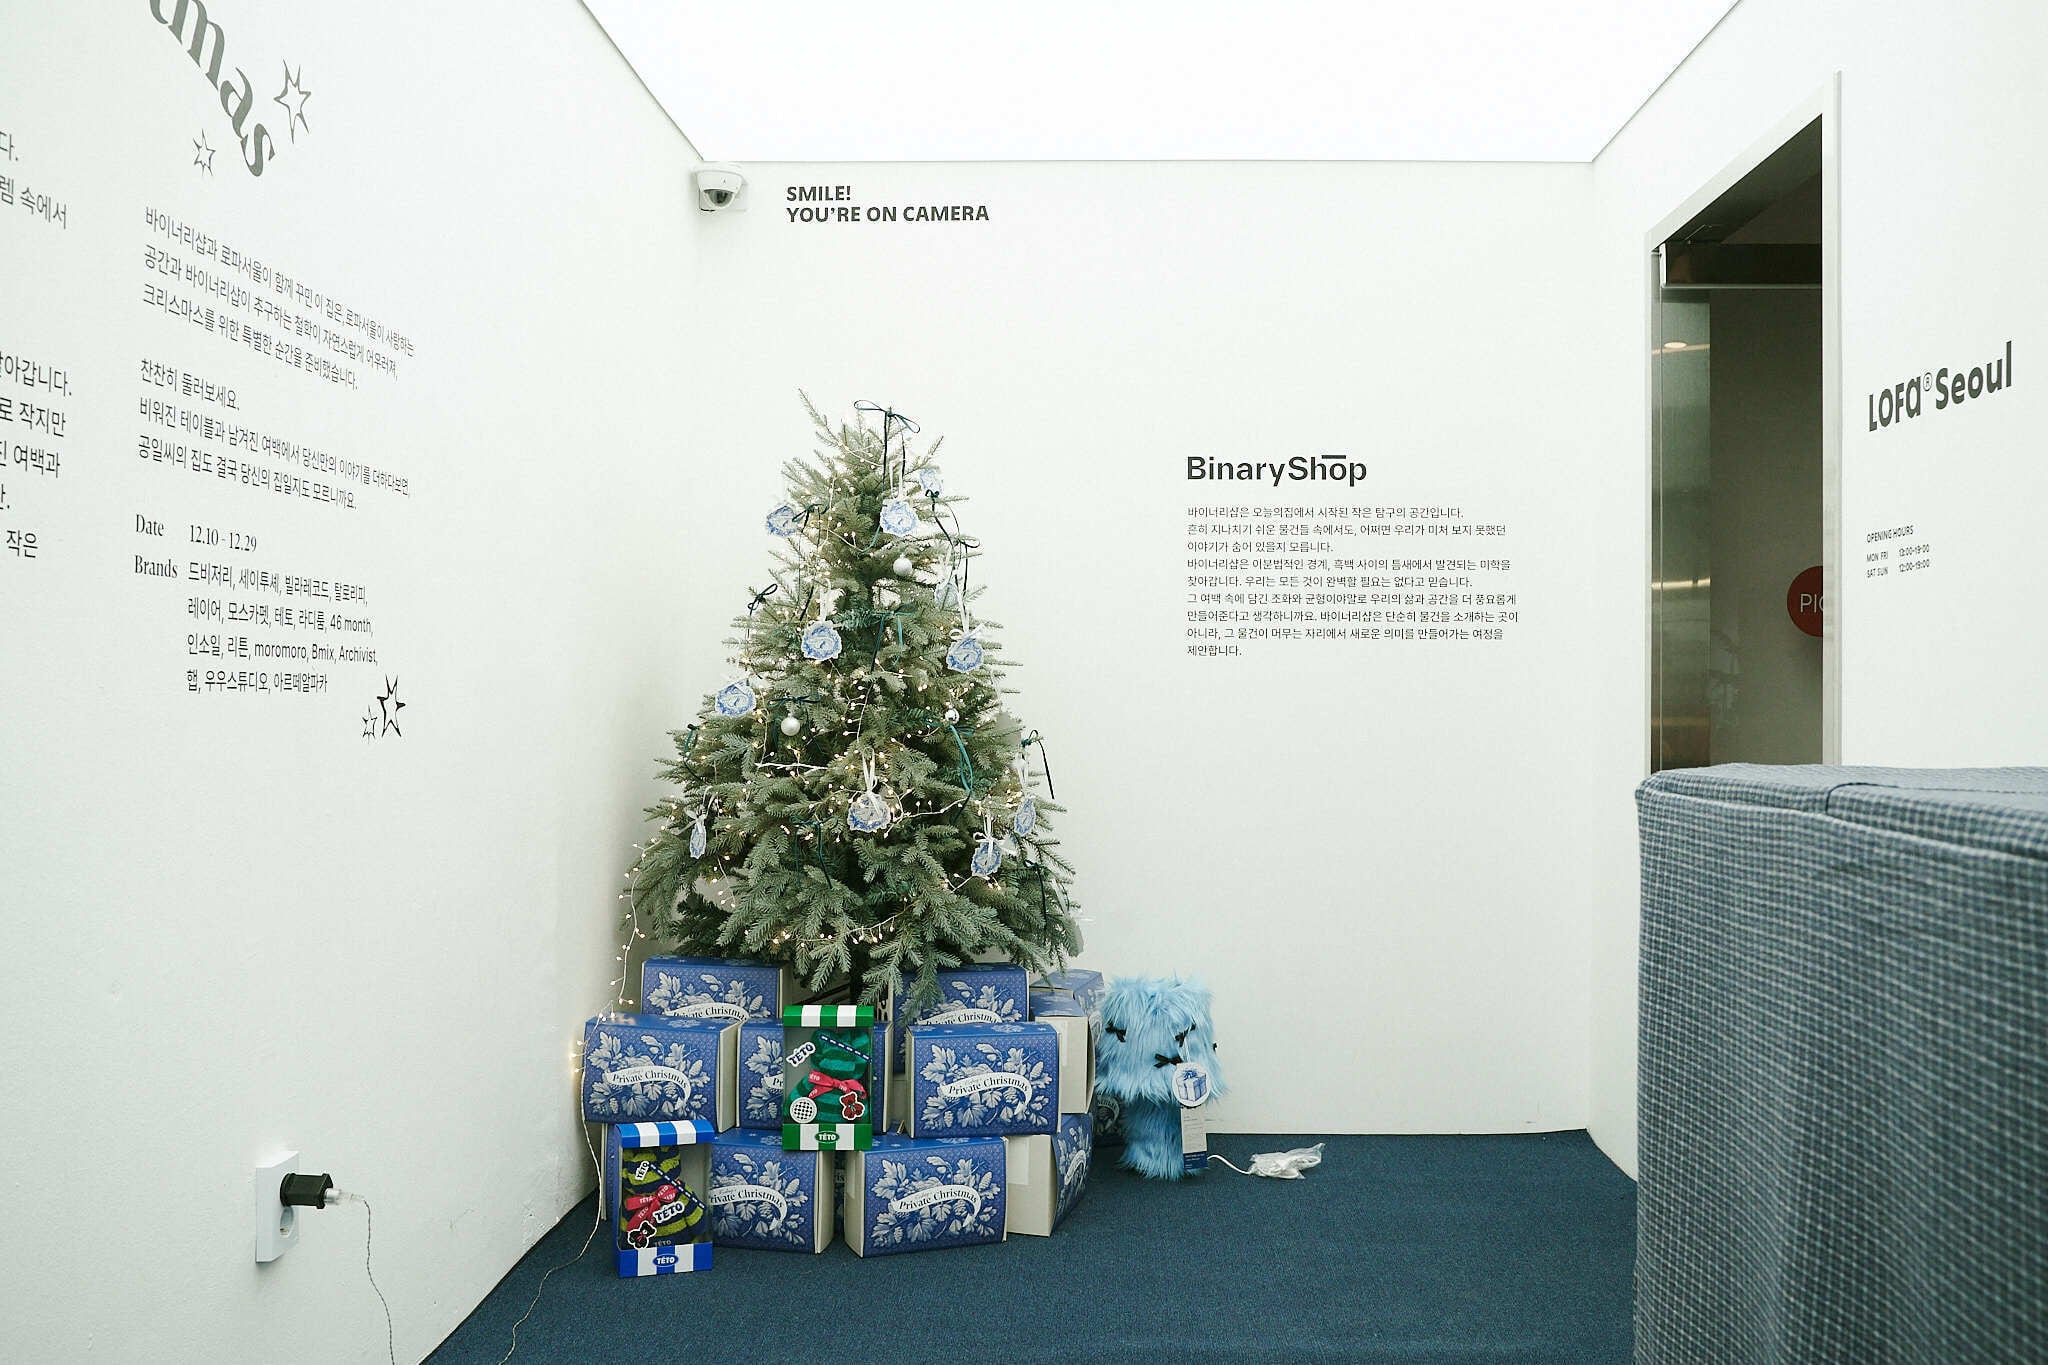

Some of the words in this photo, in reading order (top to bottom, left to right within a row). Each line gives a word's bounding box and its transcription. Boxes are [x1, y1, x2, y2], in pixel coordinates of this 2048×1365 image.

[786, 185, 851, 202] SMILE!
[20, 187, 67, 230] 속에서
[786, 206, 861, 223] YOU'RE
[866, 206, 897, 222] ON
[903, 205, 990, 222] CAMERA
[145, 206, 218, 261] 바이너리샵과
[220, 245, 272, 289] 로파서울이
[275, 271, 294, 300] 함께
[296, 282, 313, 309] 꾸민
[346, 308, 384, 344] 로파서울이
[144, 244, 182, 281] 공간과
[185, 263, 251, 313] 바이너리샵이
[253, 295, 292, 331] 추구하는
[294, 315, 321, 344] 철학이
[143, 283, 215, 332] 크리스마스를
[218, 315, 240, 342] 위한
[242, 324, 272, 356] 특별한
[275, 340, 302, 368] 순간을
[0, 353, 72, 397] 아갑니다.
[140, 358, 178, 392] 찬찬히
[181, 372, 240, 411] 둘러보세요.
[19, 402, 66, 437] 작지만
[140, 397, 176, 429] 비워진
[180, 410, 226, 443] 테이블과
[228, 424, 259, 453] 남겨진
[261, 435, 300, 465] 여백에서
[302, 447, 337, 475] 당신만의
[339, 459, 371, 485] 이야기를
[13, 445, 61, 478] 여백과
[138, 434, 187, 469] 공일씨의
[191, 448, 213, 473] 집도
[216, 456, 238, 481] 결국
[240, 463, 270, 490] 당신의
[273, 472, 310, 497] 집일지도
[1188, 506, 1249, 518] 바이너리샵은
[1253, 506, 1314, 519] 오늘의집에서
[1318, 506, 1348, 519] 시작된
[1352, 507, 1372, 519] 작은
[1375, 507, 1406, 519] 탐구의
[1409, 507, 1464, 519] 공간입니다.
[135, 513, 165, 537] Date
[189, 524, 219, 546] 12.10
[229, 532, 257, 551] 12.29
[1187, 523, 1208, 536] 흔히
[1211, 523, 1252, 535] 지나치기
[1255, 524, 1275, 536] 쉬운
[1279, 524, 1309, 536] 물건들
[1313, 524, 1357, 537] 속에서도,
[1360, 524, 1391, 536] 어쩌면
[1394, 524, 1425, 536] 우리가
[1428, 524, 1449, 536] 미처
[1452, 524, 1472, 535] 보지
[1475, 524, 1506, 536] 못했던
[1866, 529, 1892, 543] OPENING
[1893, 524, 1914, 538] HOURS
[6, 529, 38, 558] 작은
[1187, 541, 1228, 553] 이야기가
[1232, 541, 1252, 553] 숨어
[1255, 541, 1286, 553] 있을지
[134, 555, 178, 579] Brands
[1187, 558, 1250, 570] 바이너리샵은
[1252, 558, 1304, 571] 이분법적인
[1334, 559, 1354, 571] 흑백
[1357, 559, 1388, 571] 사이의
[1391, 559, 1432, 571] 틈새에서
[1435, 559, 1477, 571] 발견되는
[1480, 559, 1511, 571] 미학을
[1866, 552, 1879, 562] MON
[188, 561, 236, 591] 드비저리,
[285, 575, 332, 602] 빌라레코드,
[1187, 575, 1242, 588] 찾아갑니다.
[1245, 575, 1276, 588] 우리는
[1279, 576, 1299, 588] 모든
[1302, 576, 1323, 588] 것이
[1326, 576, 1357, 588] 완벽할
[1360, 576, 1391, 588] 필요는
[1394, 576, 1425, 588] 없다고
[1428, 576, 1473, 588] 믿습니다.
[1200, 593, 1221, 605] 여백
[1224, 593, 1245, 605] 속에
[1247, 593, 1268, 605] 담긴
[1271, 593, 1303, 605] 조화와
[1370, 593, 1401, 605] 우리의
[1404, 593, 1425, 606] 삶과
[1428, 593, 1458, 606] 공간을
[1475, 593, 1517, 606] 풍요롭게
[188, 597, 224, 624] 레이어,
[274, 606, 296, 630] 테토,
[330, 614, 341, 630] 46
[344, 618, 373, 638] month,
[1187, 610, 1249, 622] 만들어준다고
[1252, 610, 1317, 622] 생각하니까요.
[1320, 610, 1382, 623] 바이너리샵은
[1385, 609, 1416, 623] 단순히
[1419, 610, 1450, 623] 물건을
[1453, 611, 1495, 623] 소개하는
[1498, 611, 1518, 623] 곳이
[1187, 627, 1221, 640] 아니라,
[1238, 627, 1268, 640] 물건이
[1271, 628, 1302, 640] 머무는
[1305, 627, 1346, 640] 자리에서
[1350, 628, 1381, 640] 새로운
[1384, 628, 1414, 640] 의미를
[1417, 628, 1470, 640] 만들어가는
[1472, 628, 1504, 640] 여정을
[187, 632, 224, 660] 인소일,
[227, 635, 251, 660] 리튼,
[255, 643, 309, 663] moromoro,
[312, 643, 337, 664] Bmix,
[339, 644, 378, 666] Archivist,
[1187, 644, 1242, 657] 제안합니다.
[204, 670, 271, 694] 우우스튜디오,
[612, 1073, 643, 1084] Private
[645, 1070, 687, 1089] Christmas
[949, 1082, 981, 1095] Private
[983, 1075, 1028, 1092] Christmas
[819, 1132, 837, 1141] TÉTO
[738, 1189, 783, 1208] Christmas
[899, 1197, 931, 1210] Private
[933, 1189, 977, 1203] Christmas
[655, 1203, 683, 1221] TÉTO
[656, 1256, 676, 1265] TÉTO
